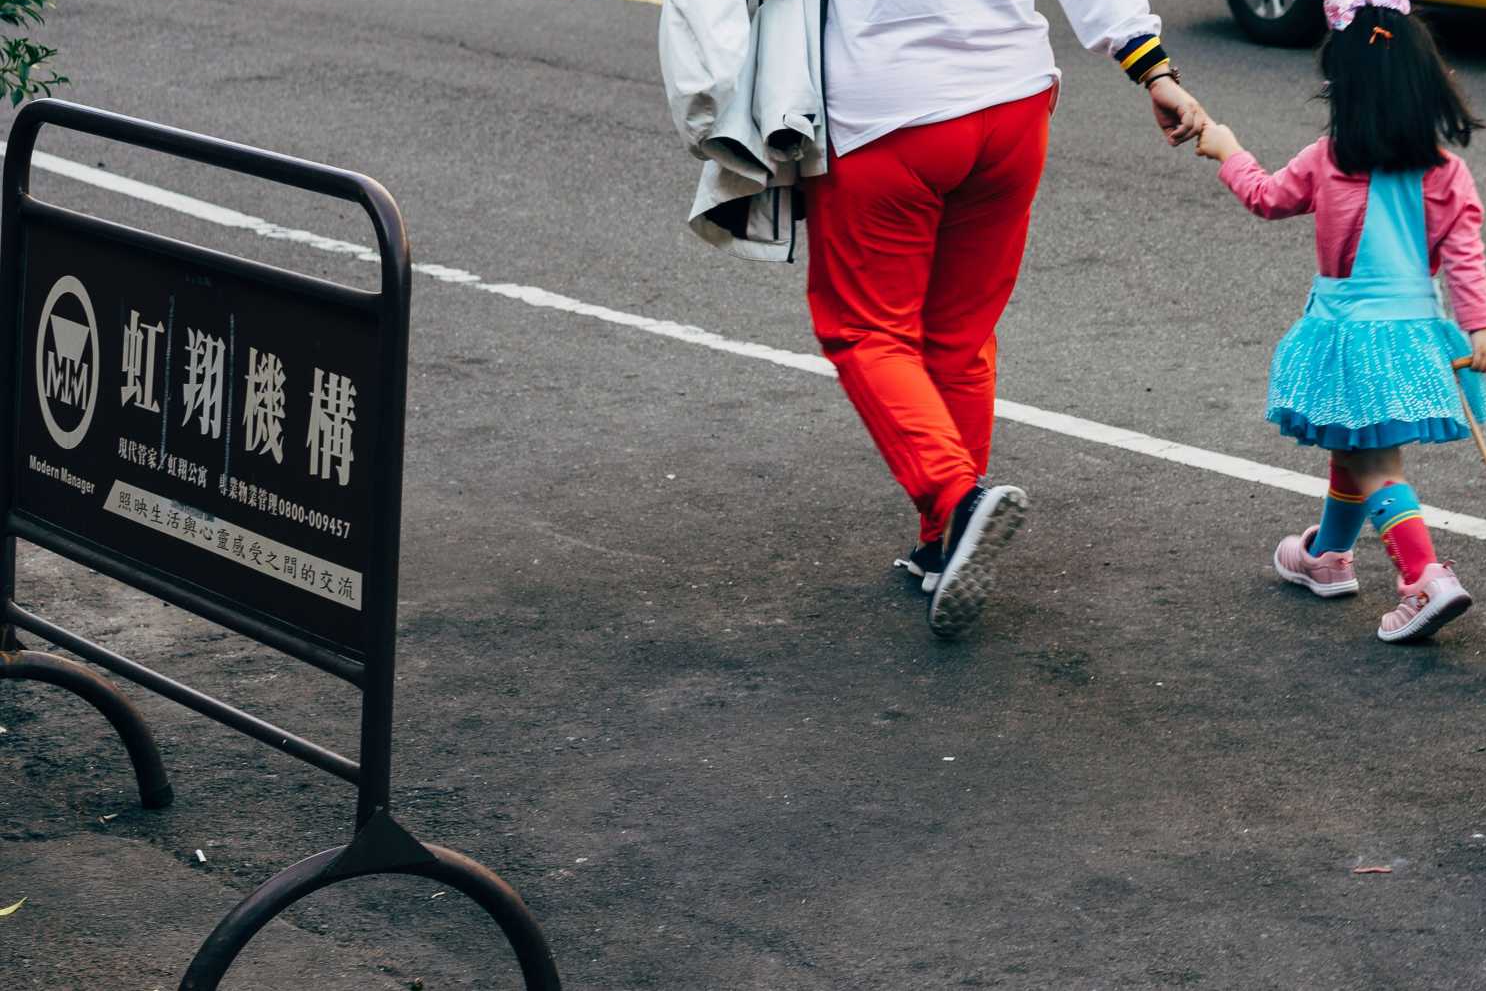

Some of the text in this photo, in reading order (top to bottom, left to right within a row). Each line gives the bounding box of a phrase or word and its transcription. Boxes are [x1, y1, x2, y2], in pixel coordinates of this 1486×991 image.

[119, 309, 357, 486] 虹翔機構
[29, 454, 96, 495] Modern Manager
[117, 490, 355, 601] 照映生活與心靈感受之間的交流
